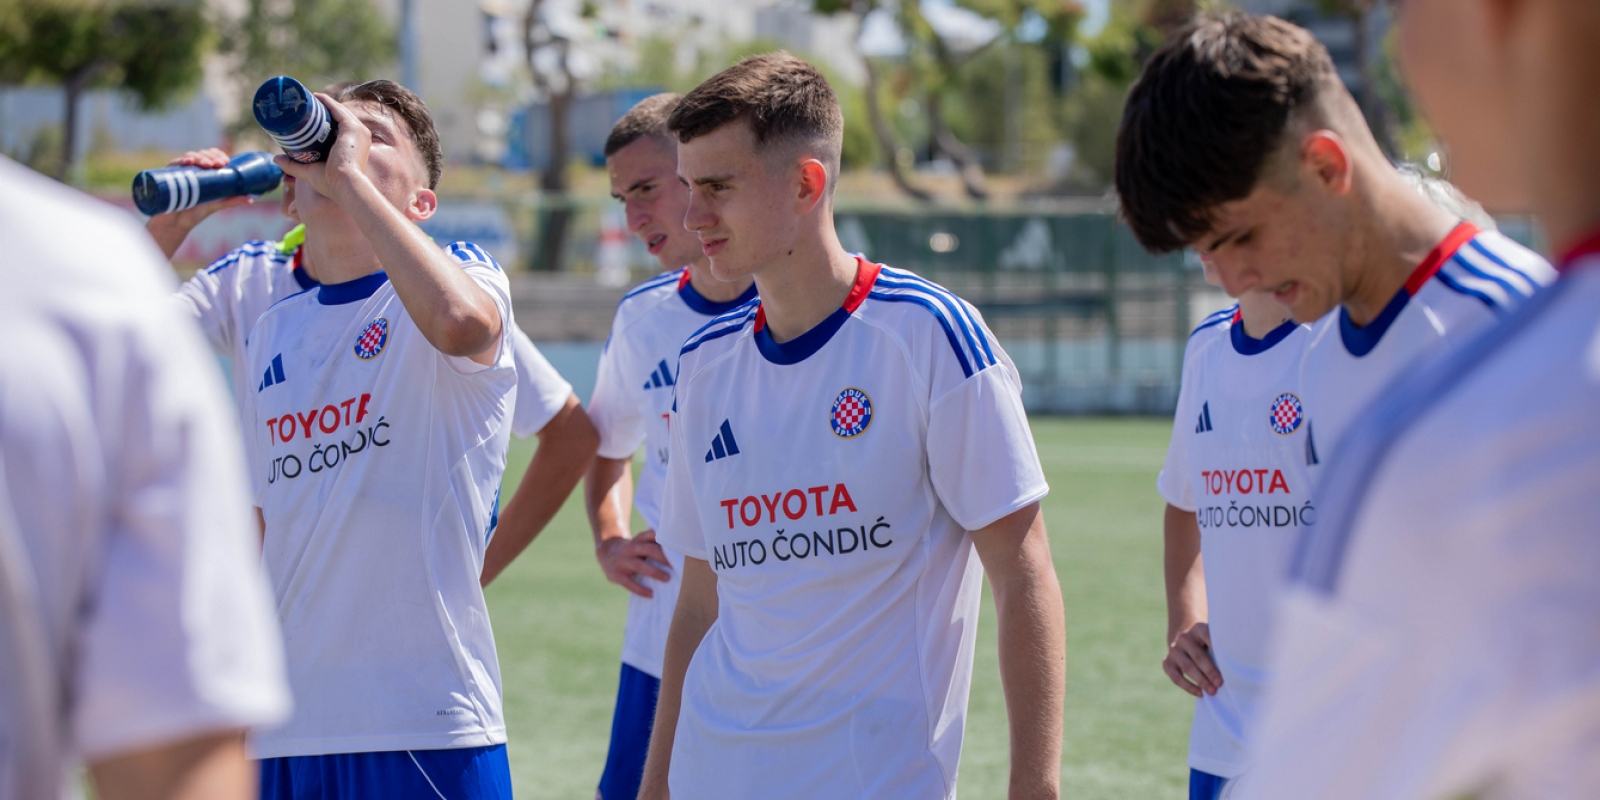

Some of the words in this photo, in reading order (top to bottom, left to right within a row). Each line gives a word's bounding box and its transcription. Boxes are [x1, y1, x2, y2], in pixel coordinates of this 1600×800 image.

[833, 389, 868, 408] HAJDUK
[834, 424, 864, 438] SPLIT
[267, 453, 302, 485] UTO
[1201, 468, 1291, 496] TOYOTA
[720, 482, 858, 530] TOYOTA
[1226, 500, 1316, 528] ČONDIĆ
[713, 538, 767, 571] AUTO
[771, 515, 893, 562] ČONDIĆ
